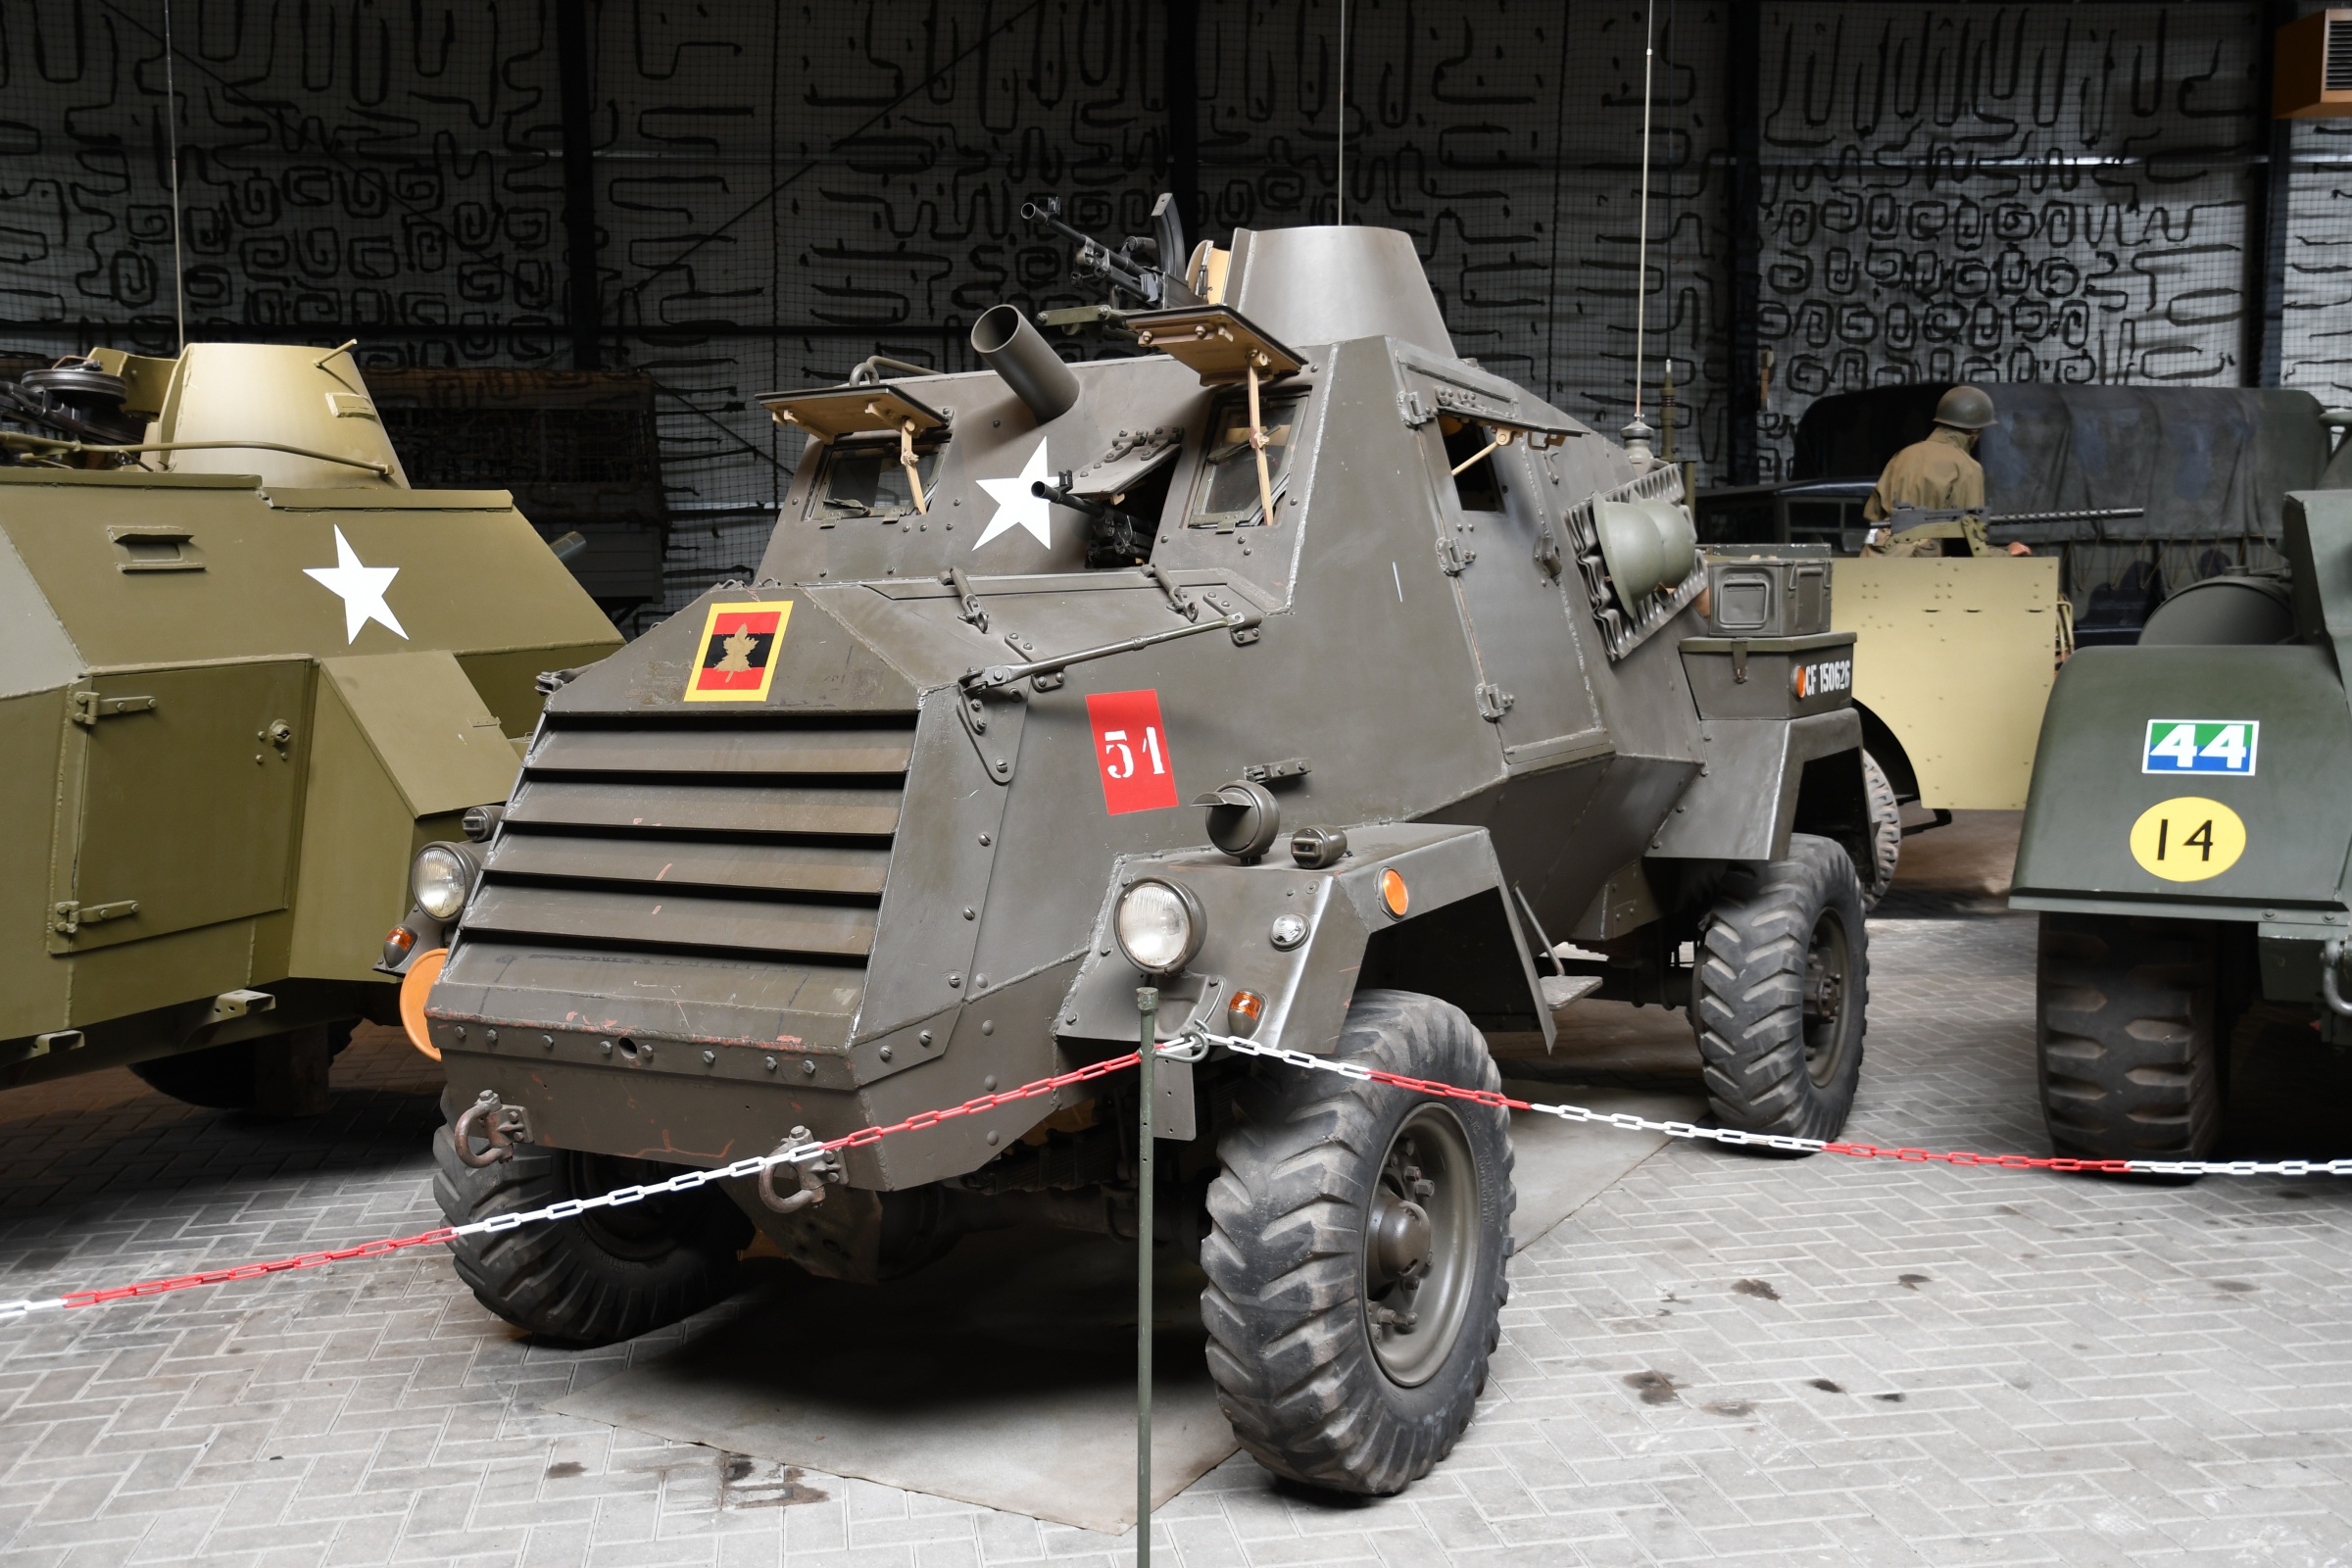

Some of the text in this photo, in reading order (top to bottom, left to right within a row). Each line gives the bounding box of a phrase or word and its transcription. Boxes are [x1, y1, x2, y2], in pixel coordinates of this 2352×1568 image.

[1805, 660, 1851, 697] CF 150626
[1104, 726, 1165, 778] 51
[2149, 724, 2247, 768] 44
[2157, 818, 2214, 861] 14
